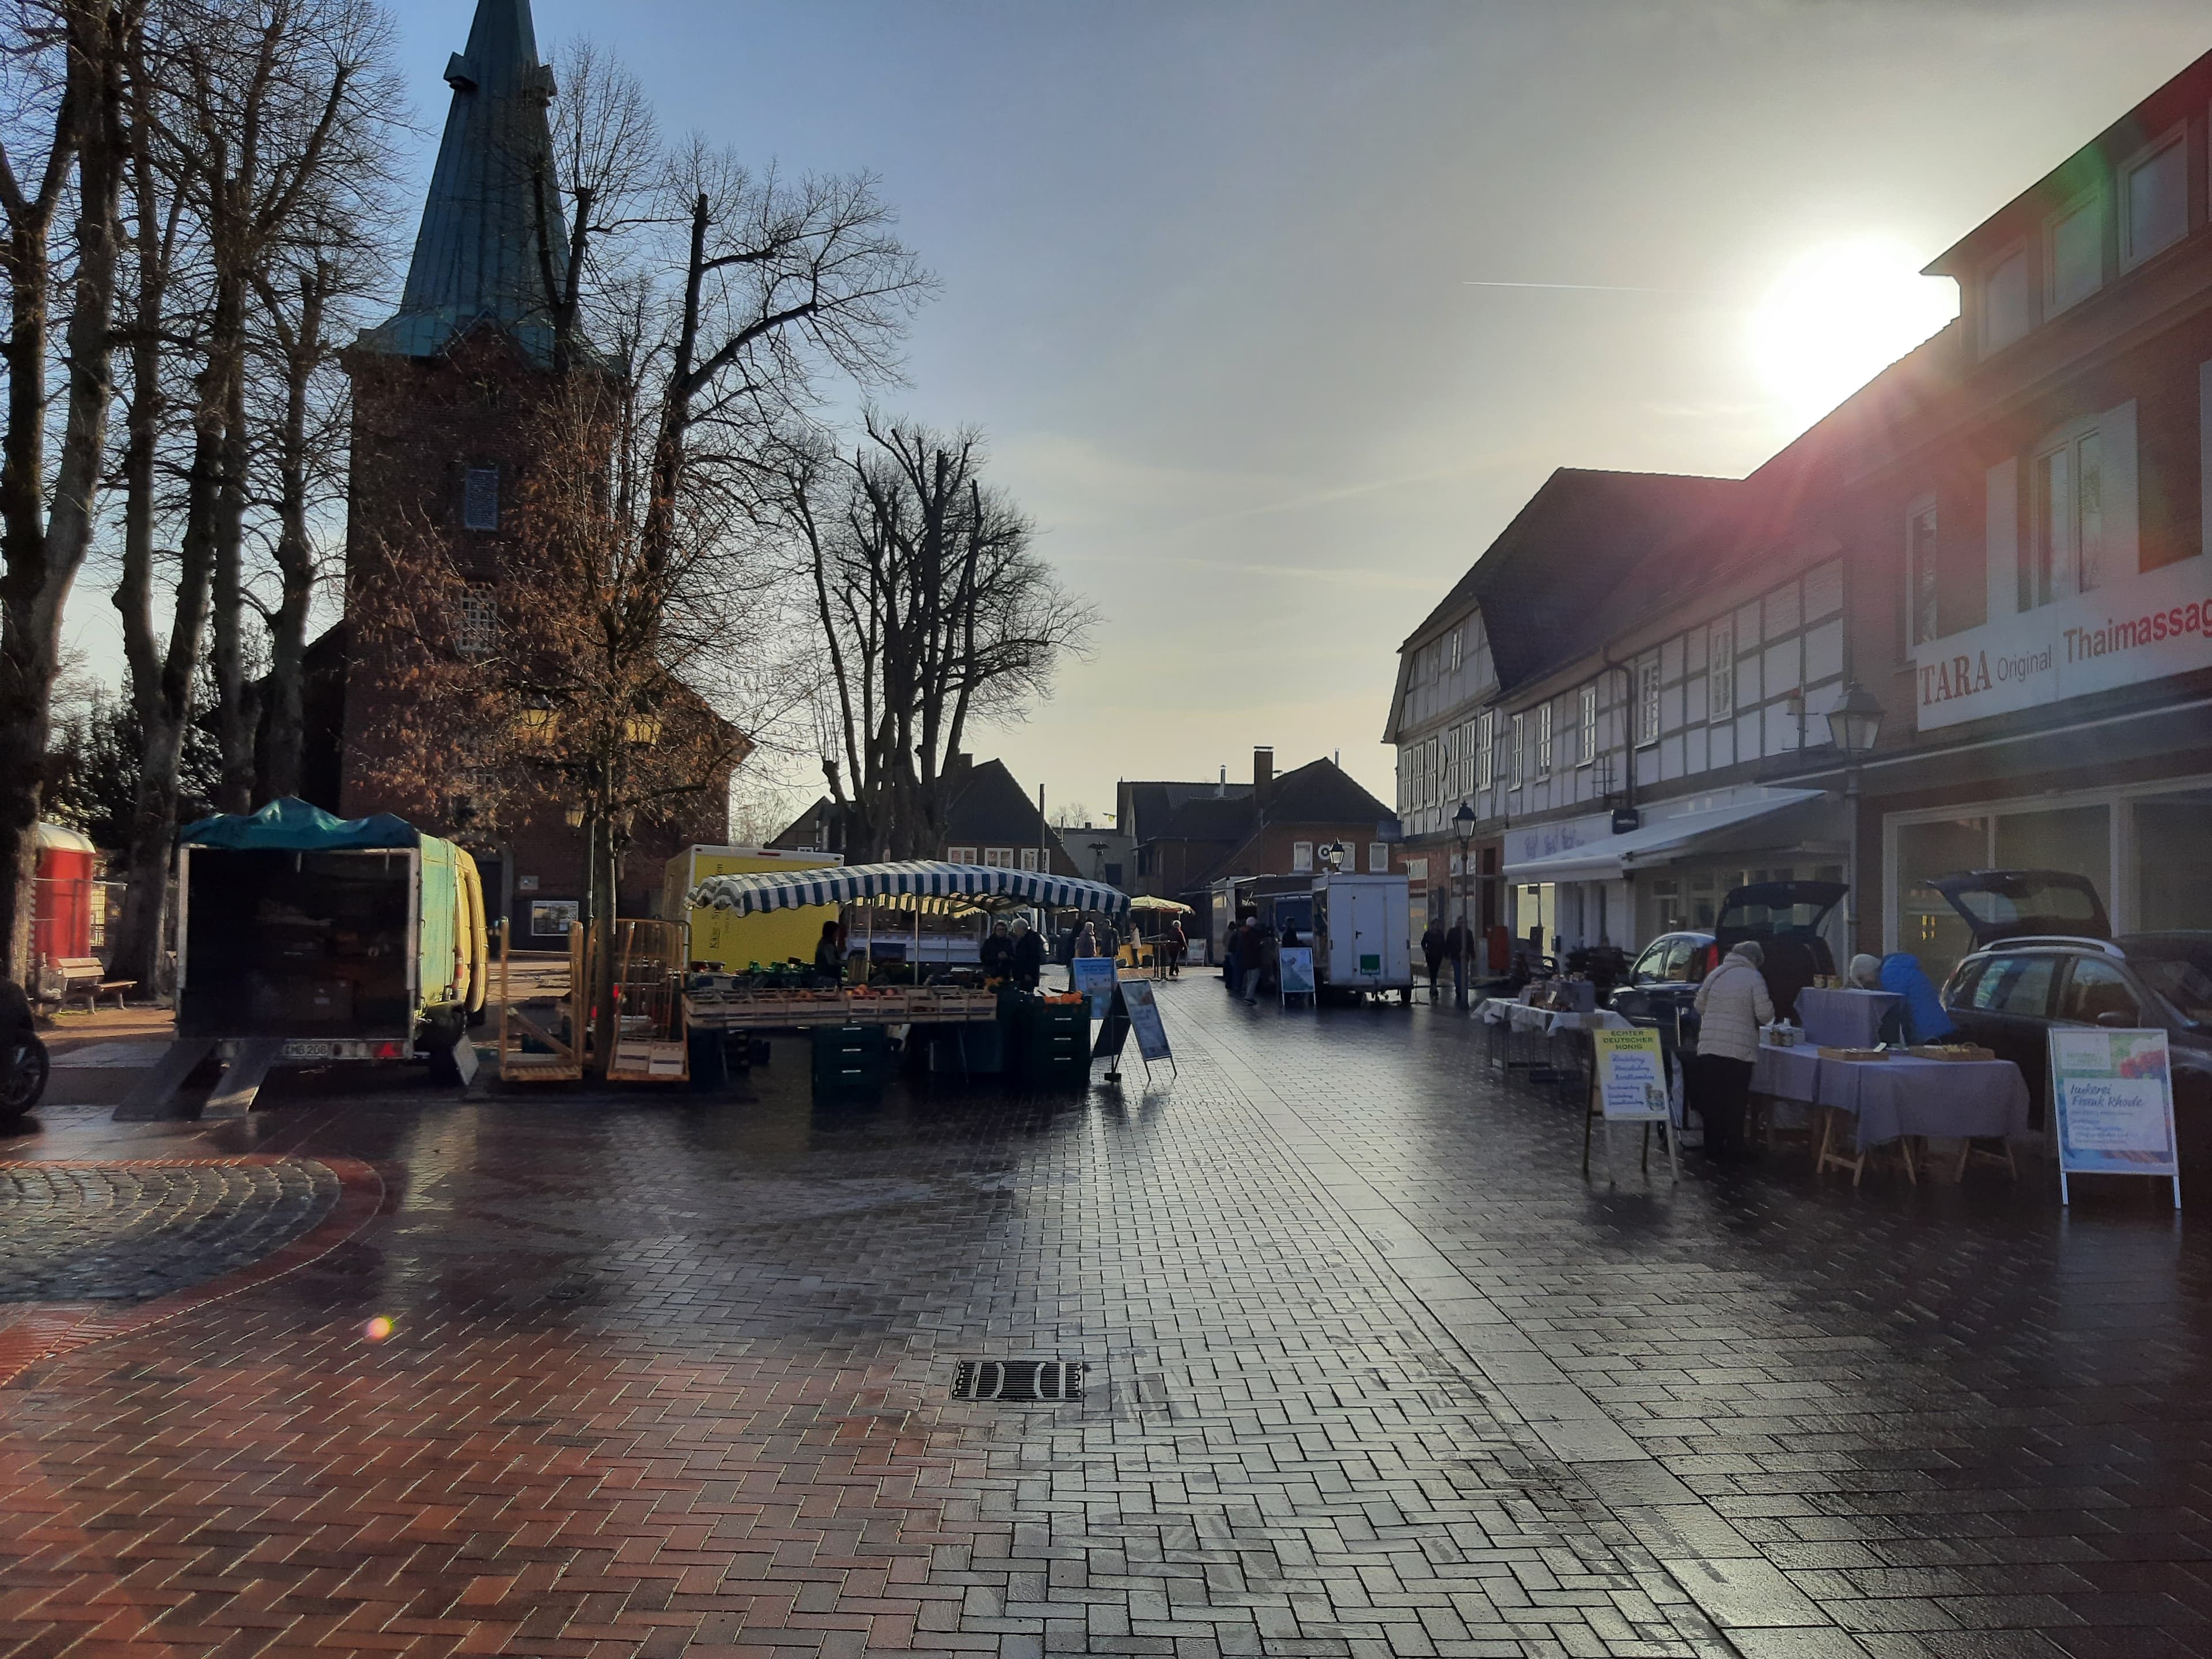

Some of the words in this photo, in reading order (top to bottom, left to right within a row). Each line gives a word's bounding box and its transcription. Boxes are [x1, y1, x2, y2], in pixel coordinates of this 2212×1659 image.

[1920, 650, 1993, 705] TARA
[1998, 646, 2052, 682] Original
[2070, 1083, 2112, 1095] Imkerei
[2072, 1096, 2104, 1107] Frank
[2108, 1094, 2144, 1107] Rhode
